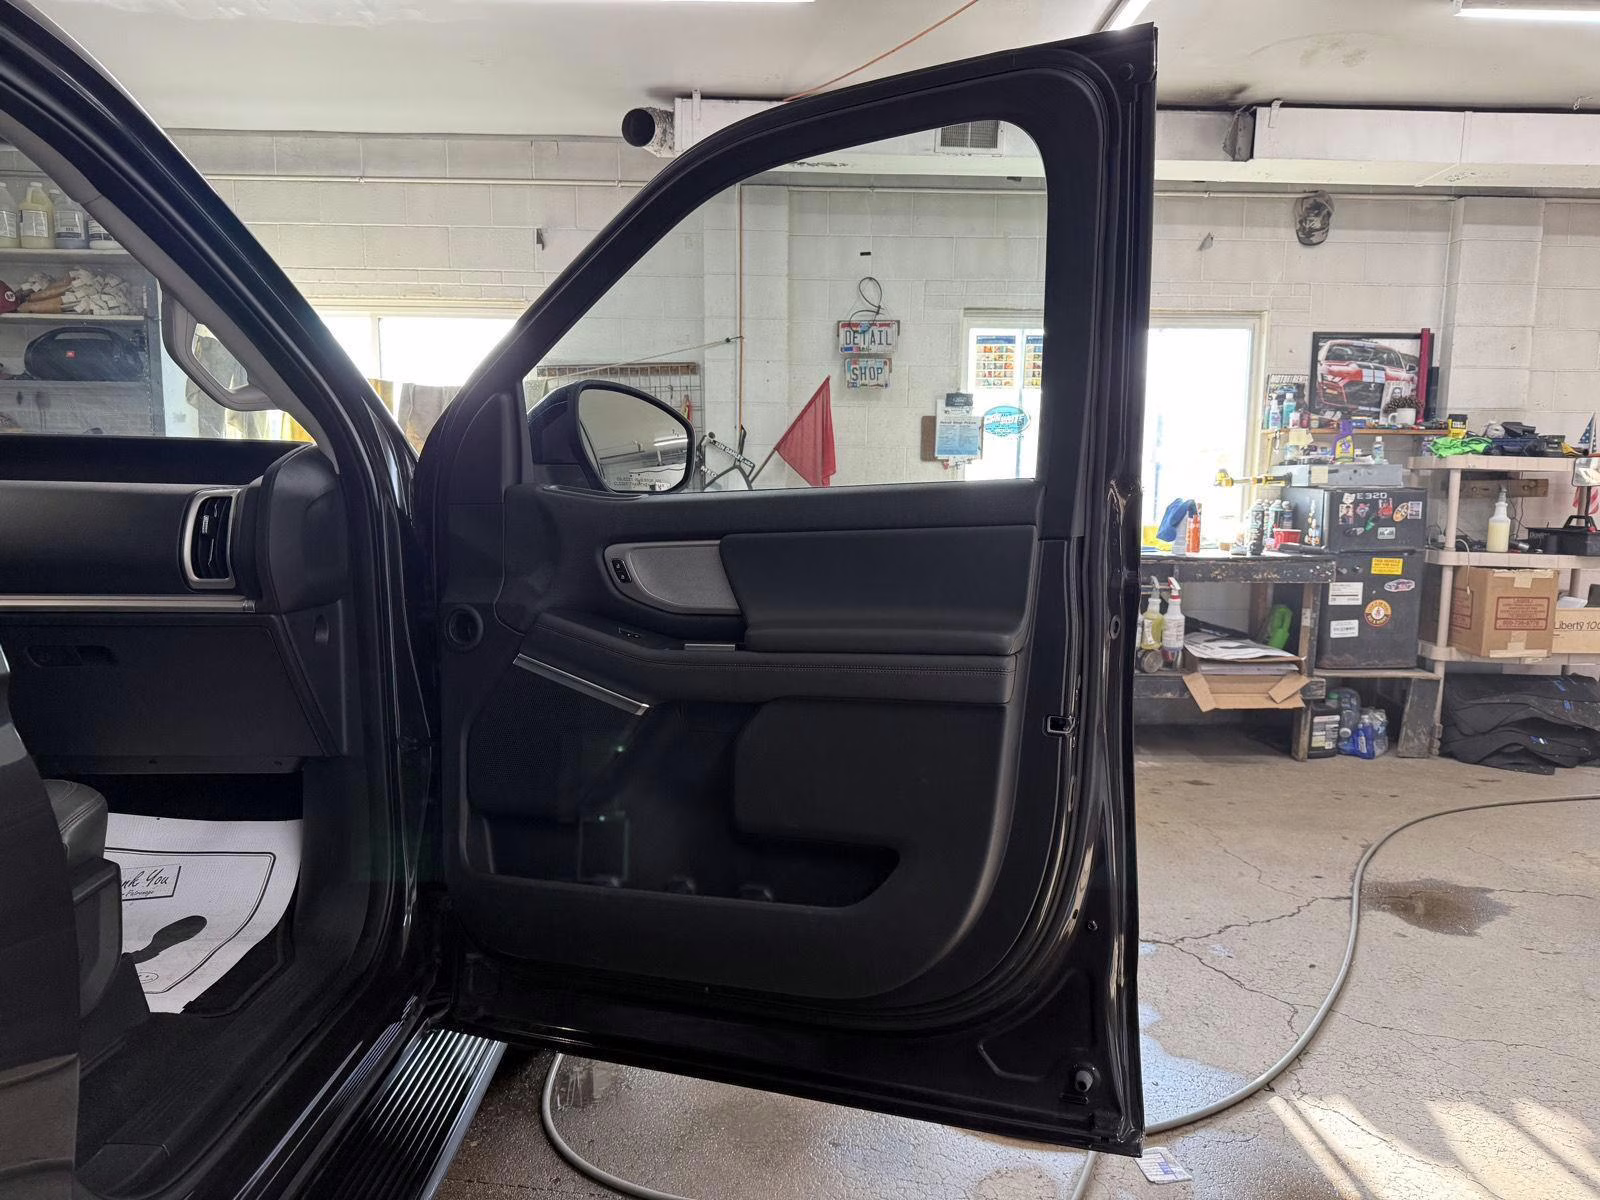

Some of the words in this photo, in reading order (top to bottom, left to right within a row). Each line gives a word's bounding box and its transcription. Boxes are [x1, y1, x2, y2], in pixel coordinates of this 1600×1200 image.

[845, 329, 892, 346] DETAIL
[851, 366, 883, 381] SHOP
[1553, 621, 1584, 631] Liberty
[146, 868, 169, 887] You
